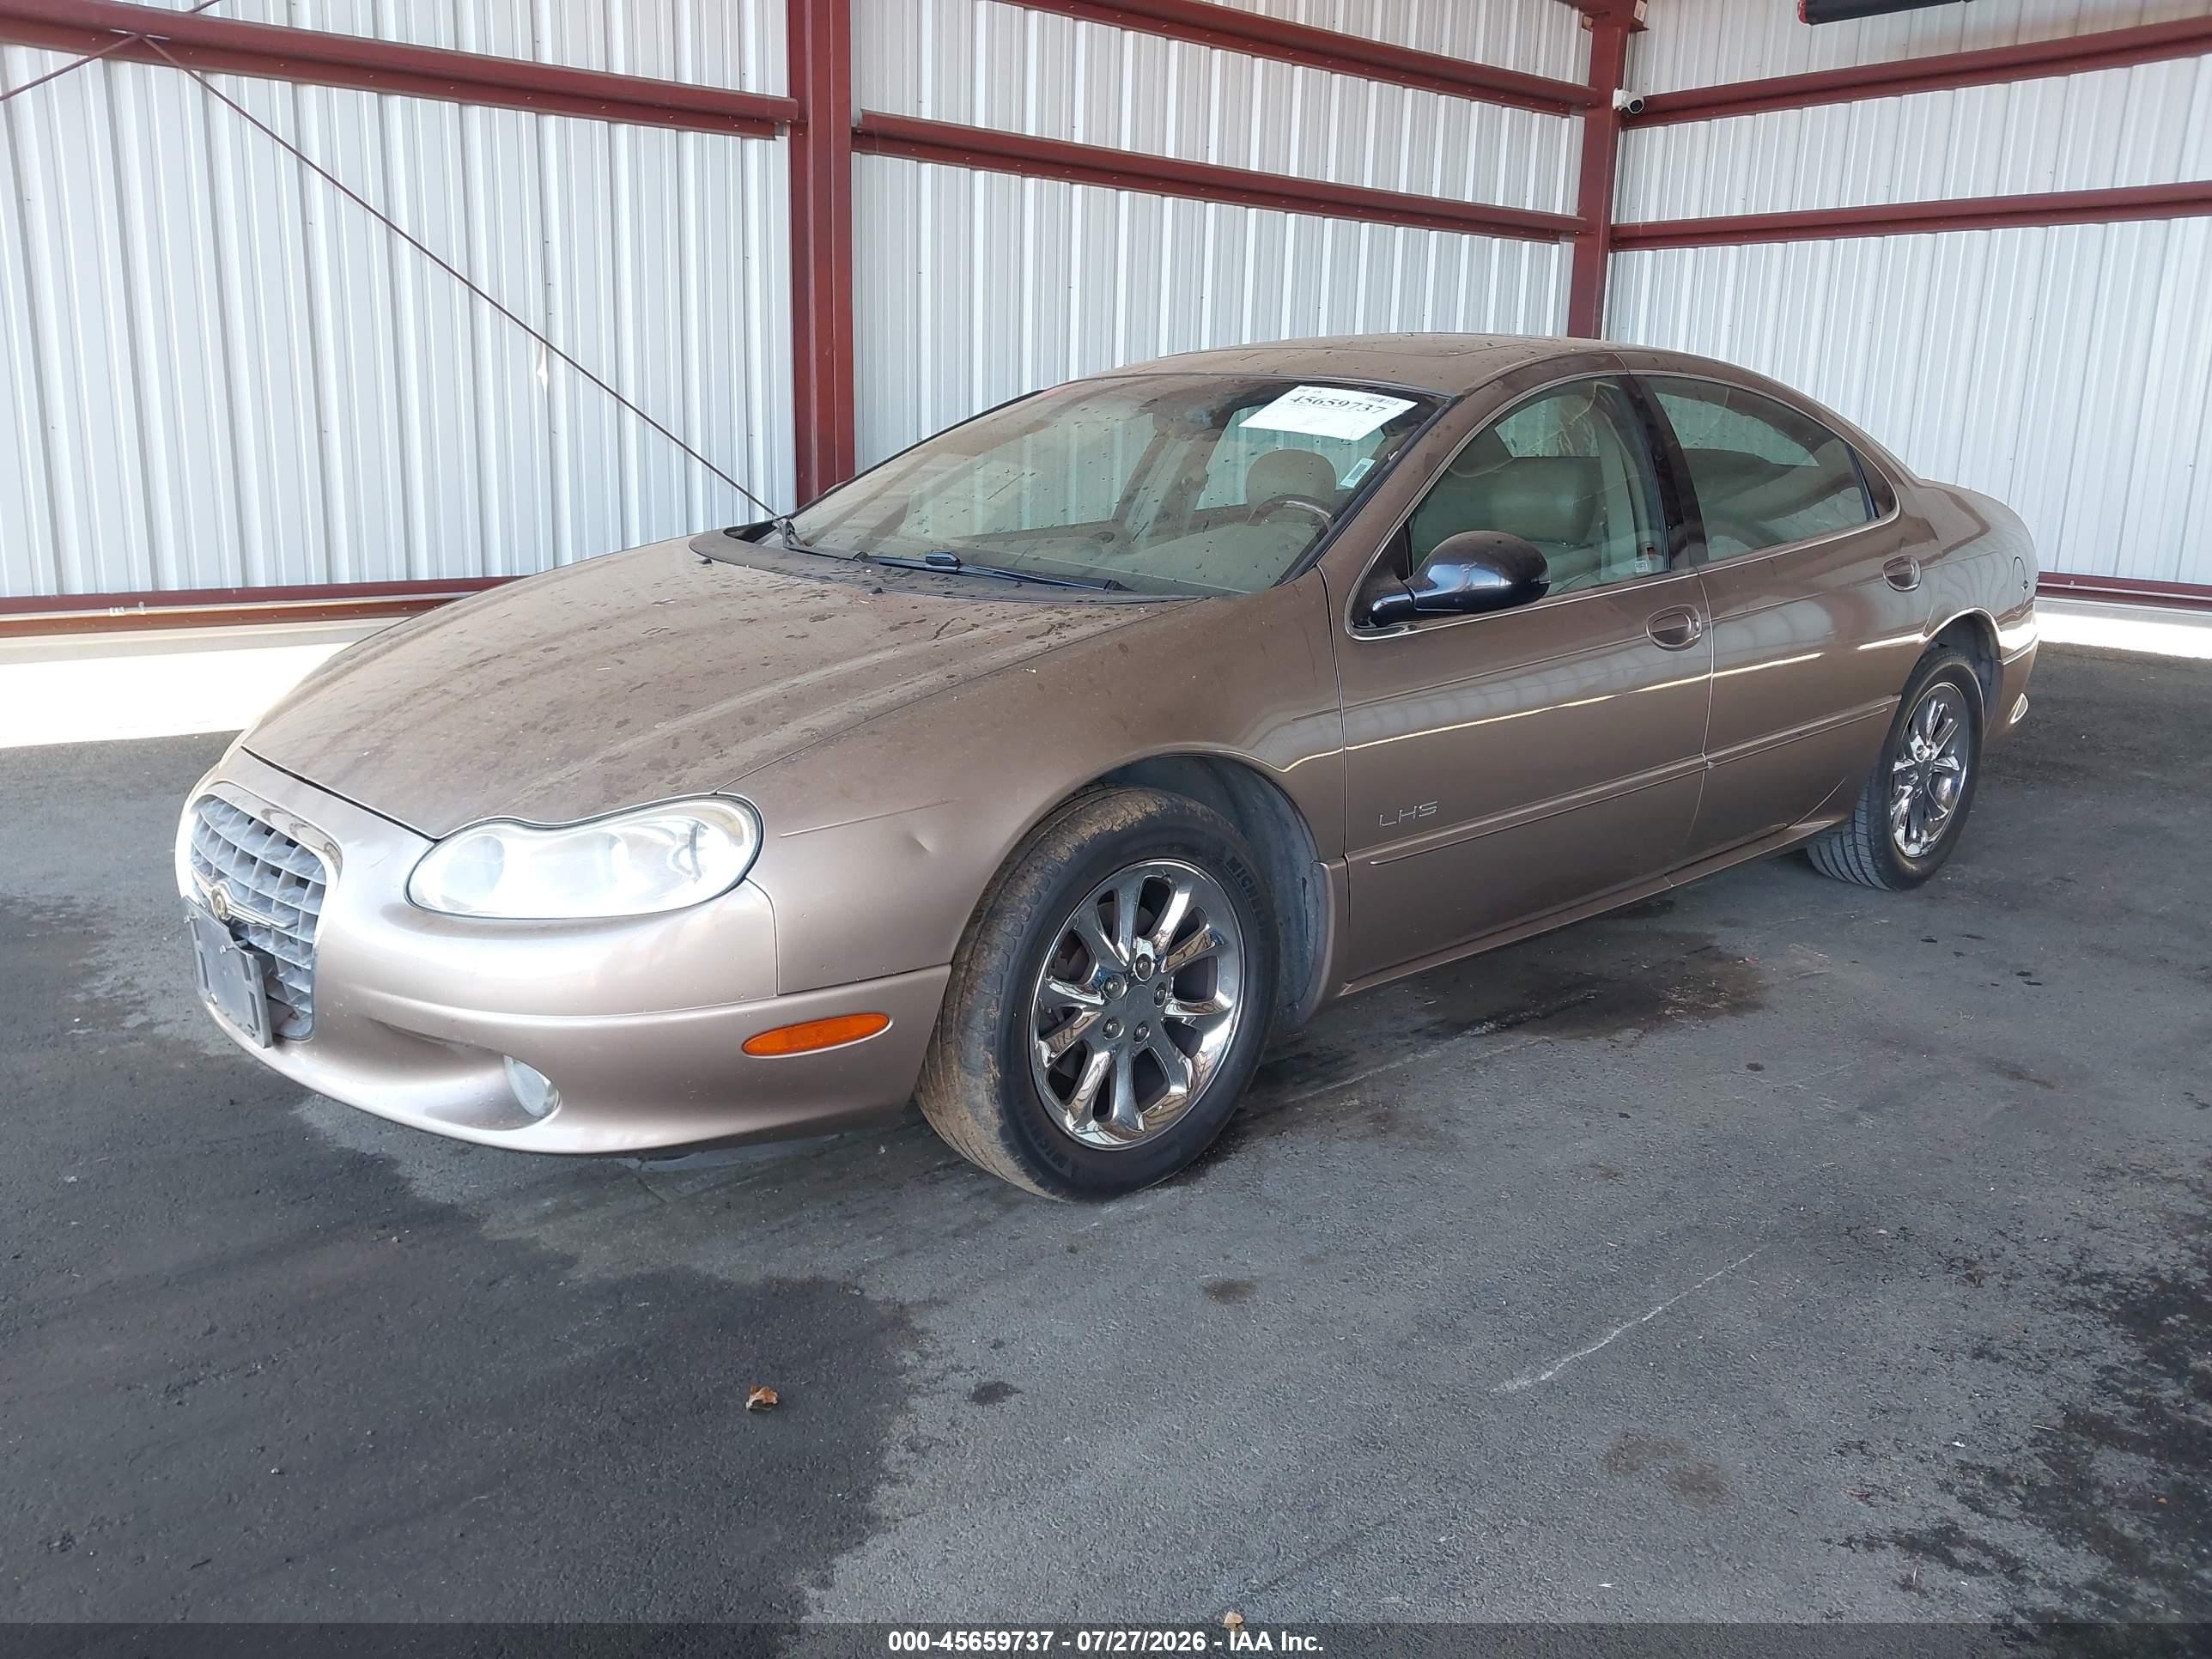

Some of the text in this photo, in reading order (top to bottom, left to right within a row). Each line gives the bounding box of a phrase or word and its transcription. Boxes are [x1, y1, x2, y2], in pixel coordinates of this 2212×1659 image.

[1290, 395, 1388, 414] 45659737
[1378, 800, 1438, 827] LHS
[1225, 856, 1267, 939] MICHELI
